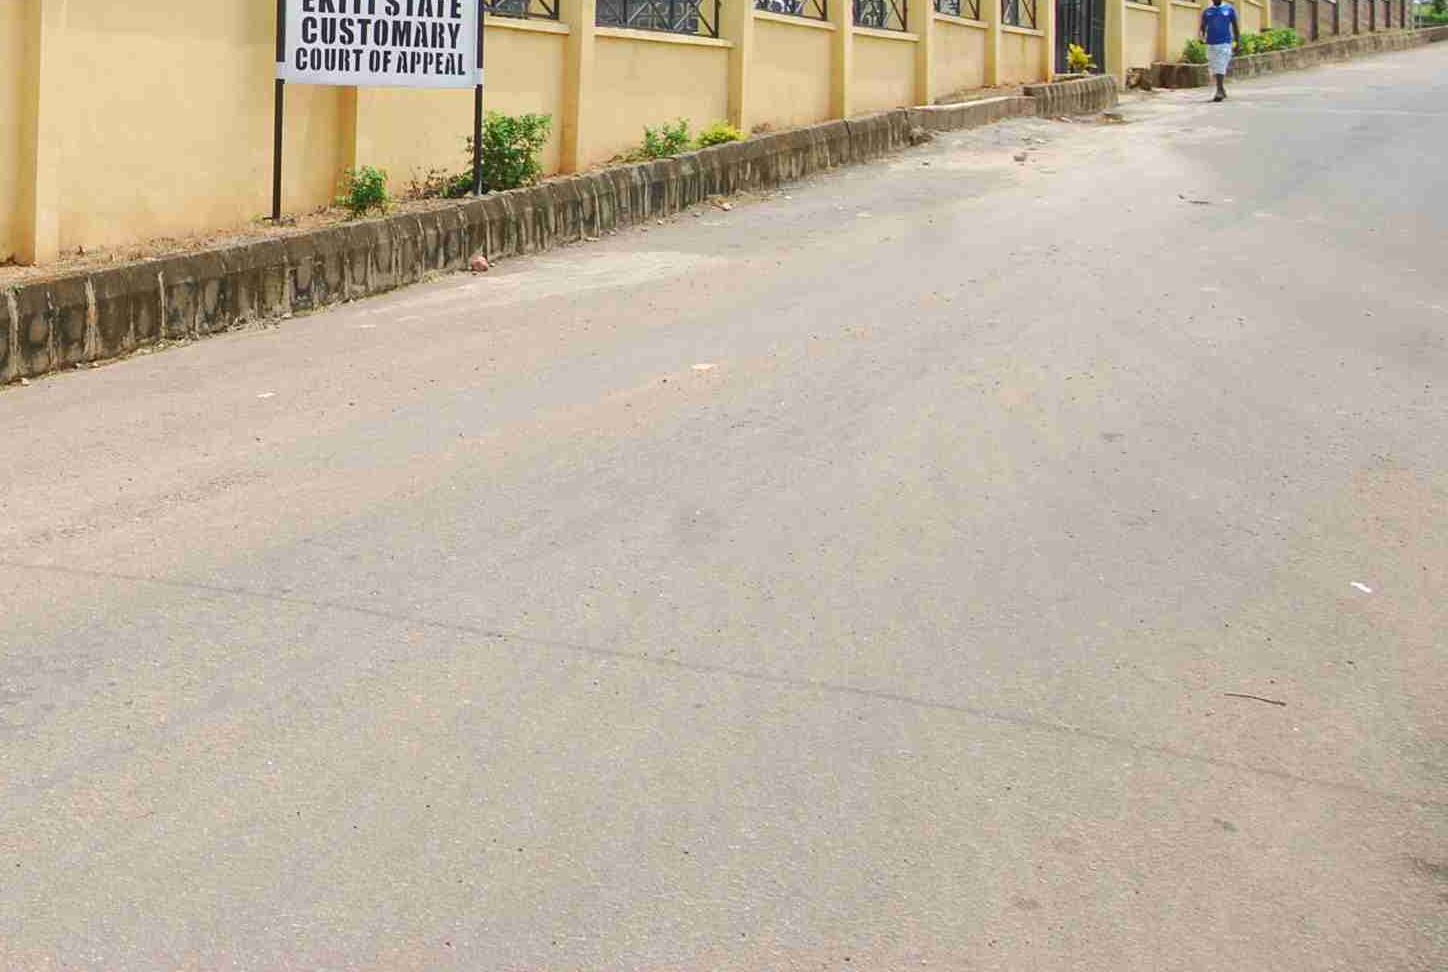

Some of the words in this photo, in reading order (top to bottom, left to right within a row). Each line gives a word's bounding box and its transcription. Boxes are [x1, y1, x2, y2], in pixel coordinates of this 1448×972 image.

[302, 16, 460, 49] CUSTOMARY
[295, 47, 363, 72] COURT
[369, 50, 391, 73] OF
[396, 51, 465, 75] APPEAL
